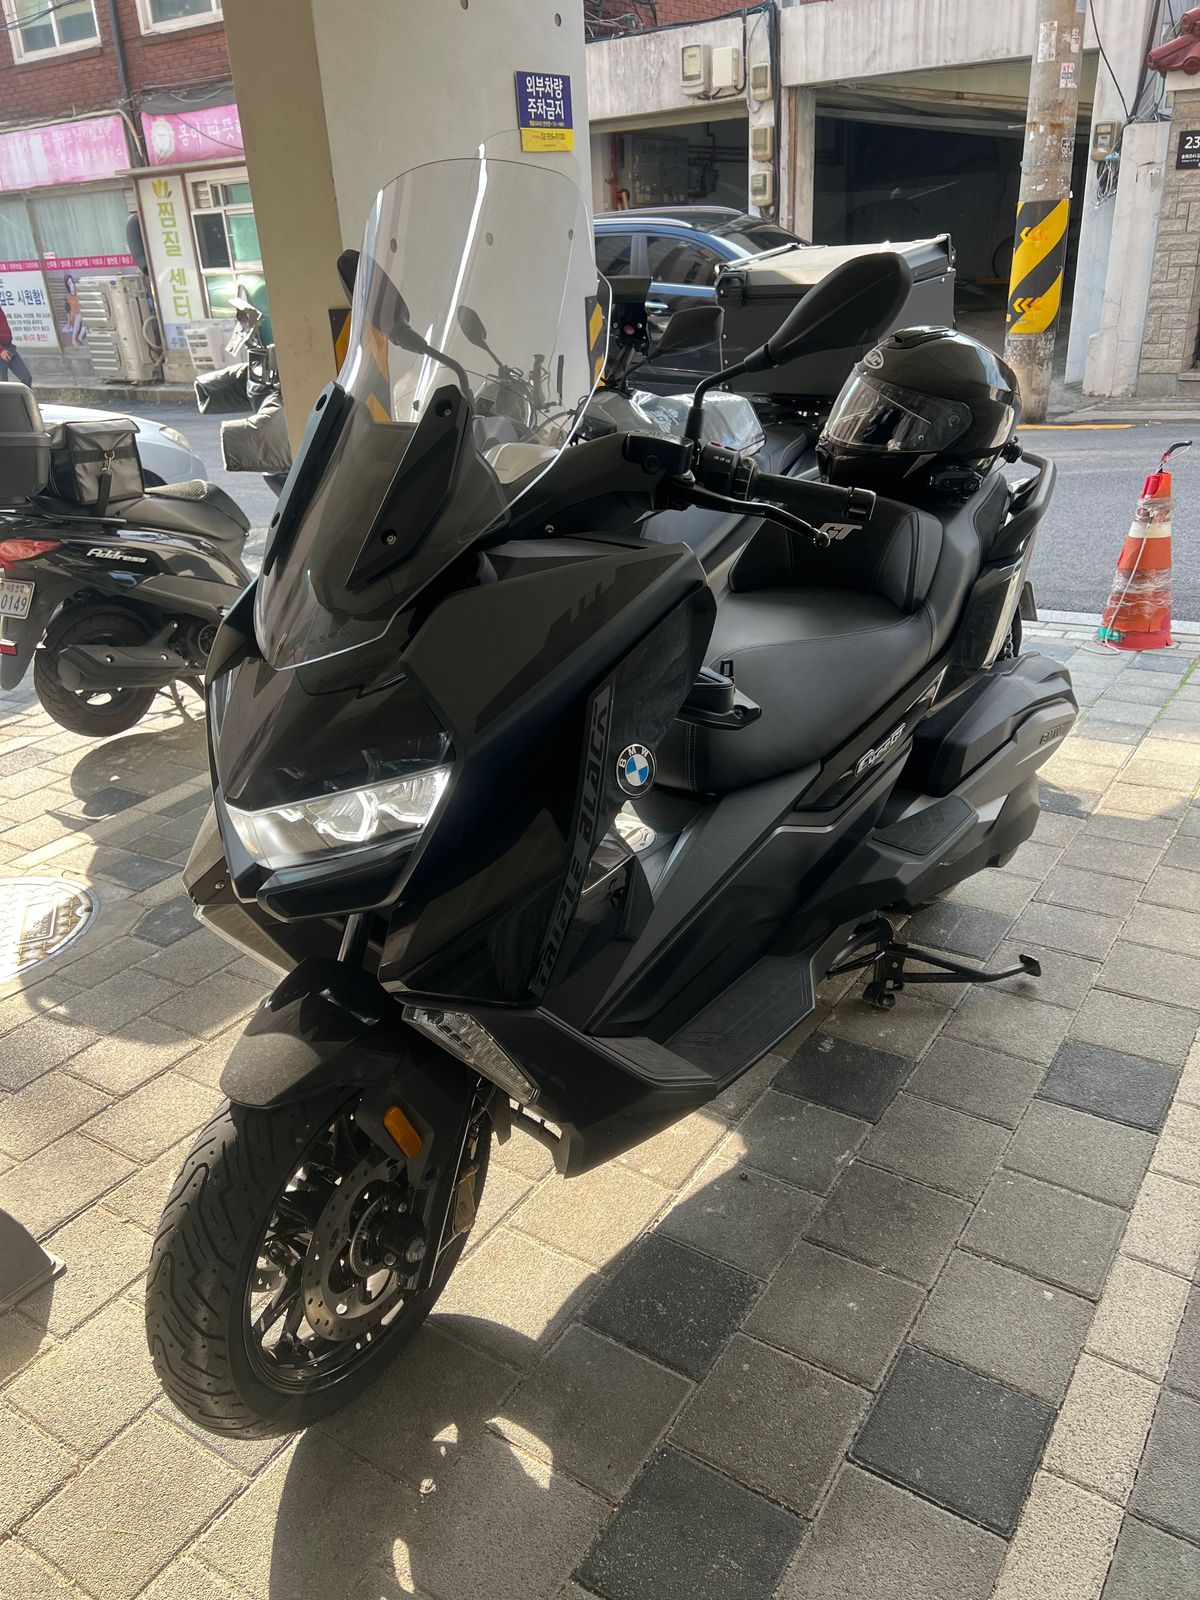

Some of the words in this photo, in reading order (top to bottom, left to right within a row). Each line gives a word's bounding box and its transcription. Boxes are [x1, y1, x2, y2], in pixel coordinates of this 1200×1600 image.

[525, 76, 563, 98] 외부차량
[527, 98, 565, 120] 주차금지
[157, 202, 182, 257] 찜질
[169, 268, 193, 319] 센터
[86, 548, 148, 563] Address
[1, 594, 27, 612] 0149
